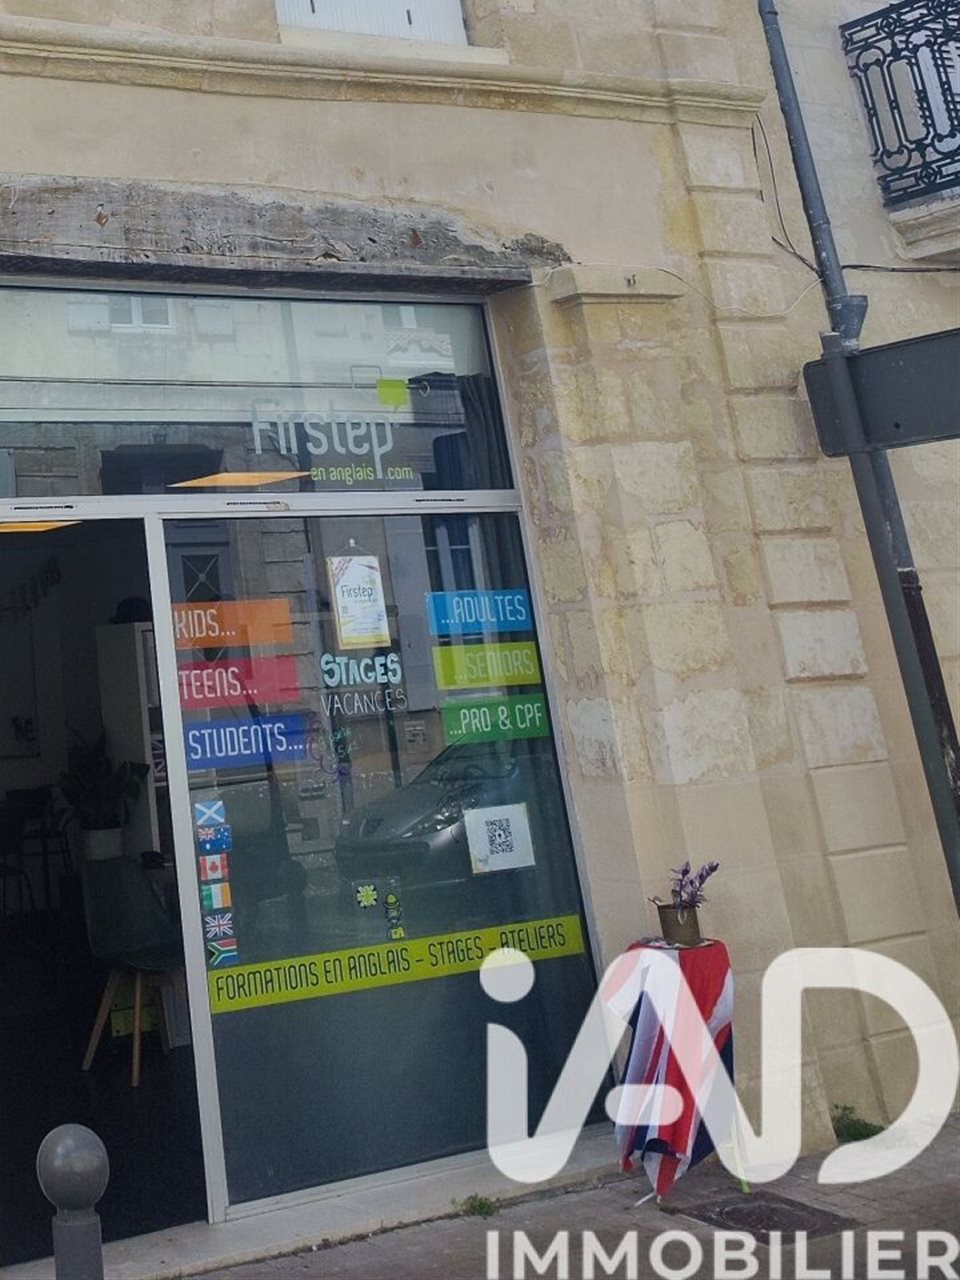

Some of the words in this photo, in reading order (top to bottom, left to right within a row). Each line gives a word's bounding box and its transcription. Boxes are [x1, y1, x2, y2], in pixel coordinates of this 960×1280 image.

[251, 398, 394, 480] Firstep
[310, 467, 327, 481] en
[330, 464, 375, 485] anglais
[320, 652, 402, 687] STAGES
[320, 687, 409, 718] VACANCES
[498, 705, 513, 731] &
[215, 962, 320, 1002] FORMATIONS
[323, 958, 344, 984] EN
[348, 947, 411, 979] ANGLAIS
[428, 935, 484, 967] STAGES
[499, 922, 567, 957] ATELIERS
